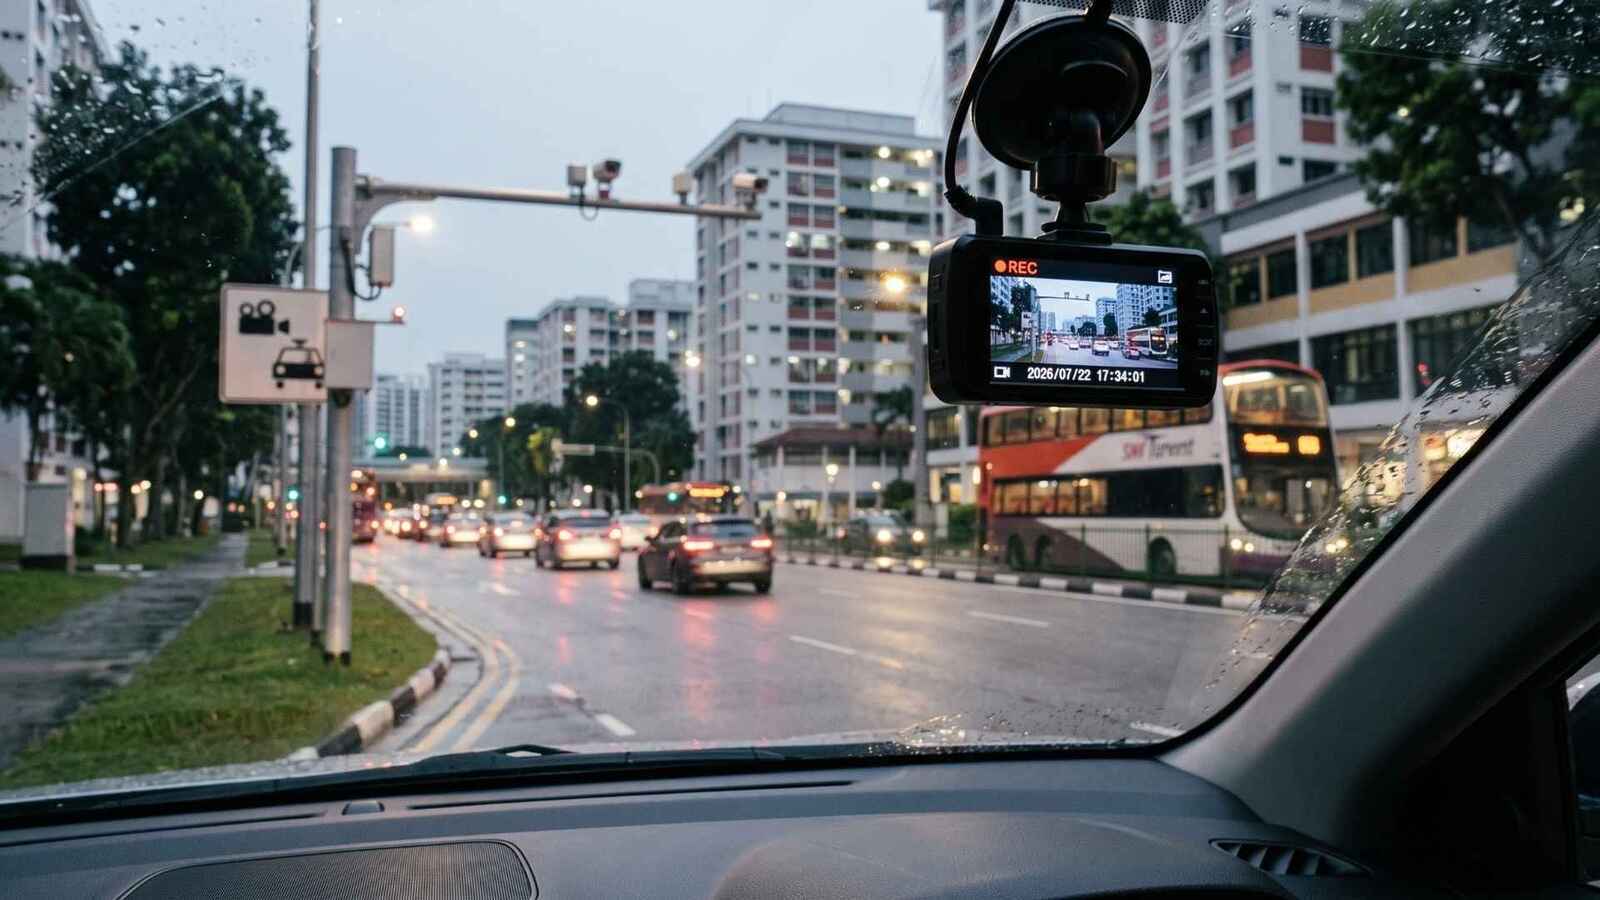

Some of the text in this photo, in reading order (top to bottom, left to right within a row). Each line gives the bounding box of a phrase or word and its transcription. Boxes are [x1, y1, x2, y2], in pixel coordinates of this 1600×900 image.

[1008, 260, 1038, 275] REC
[1027, 367, 1145, 383] 2026/07/22 17:34:01
